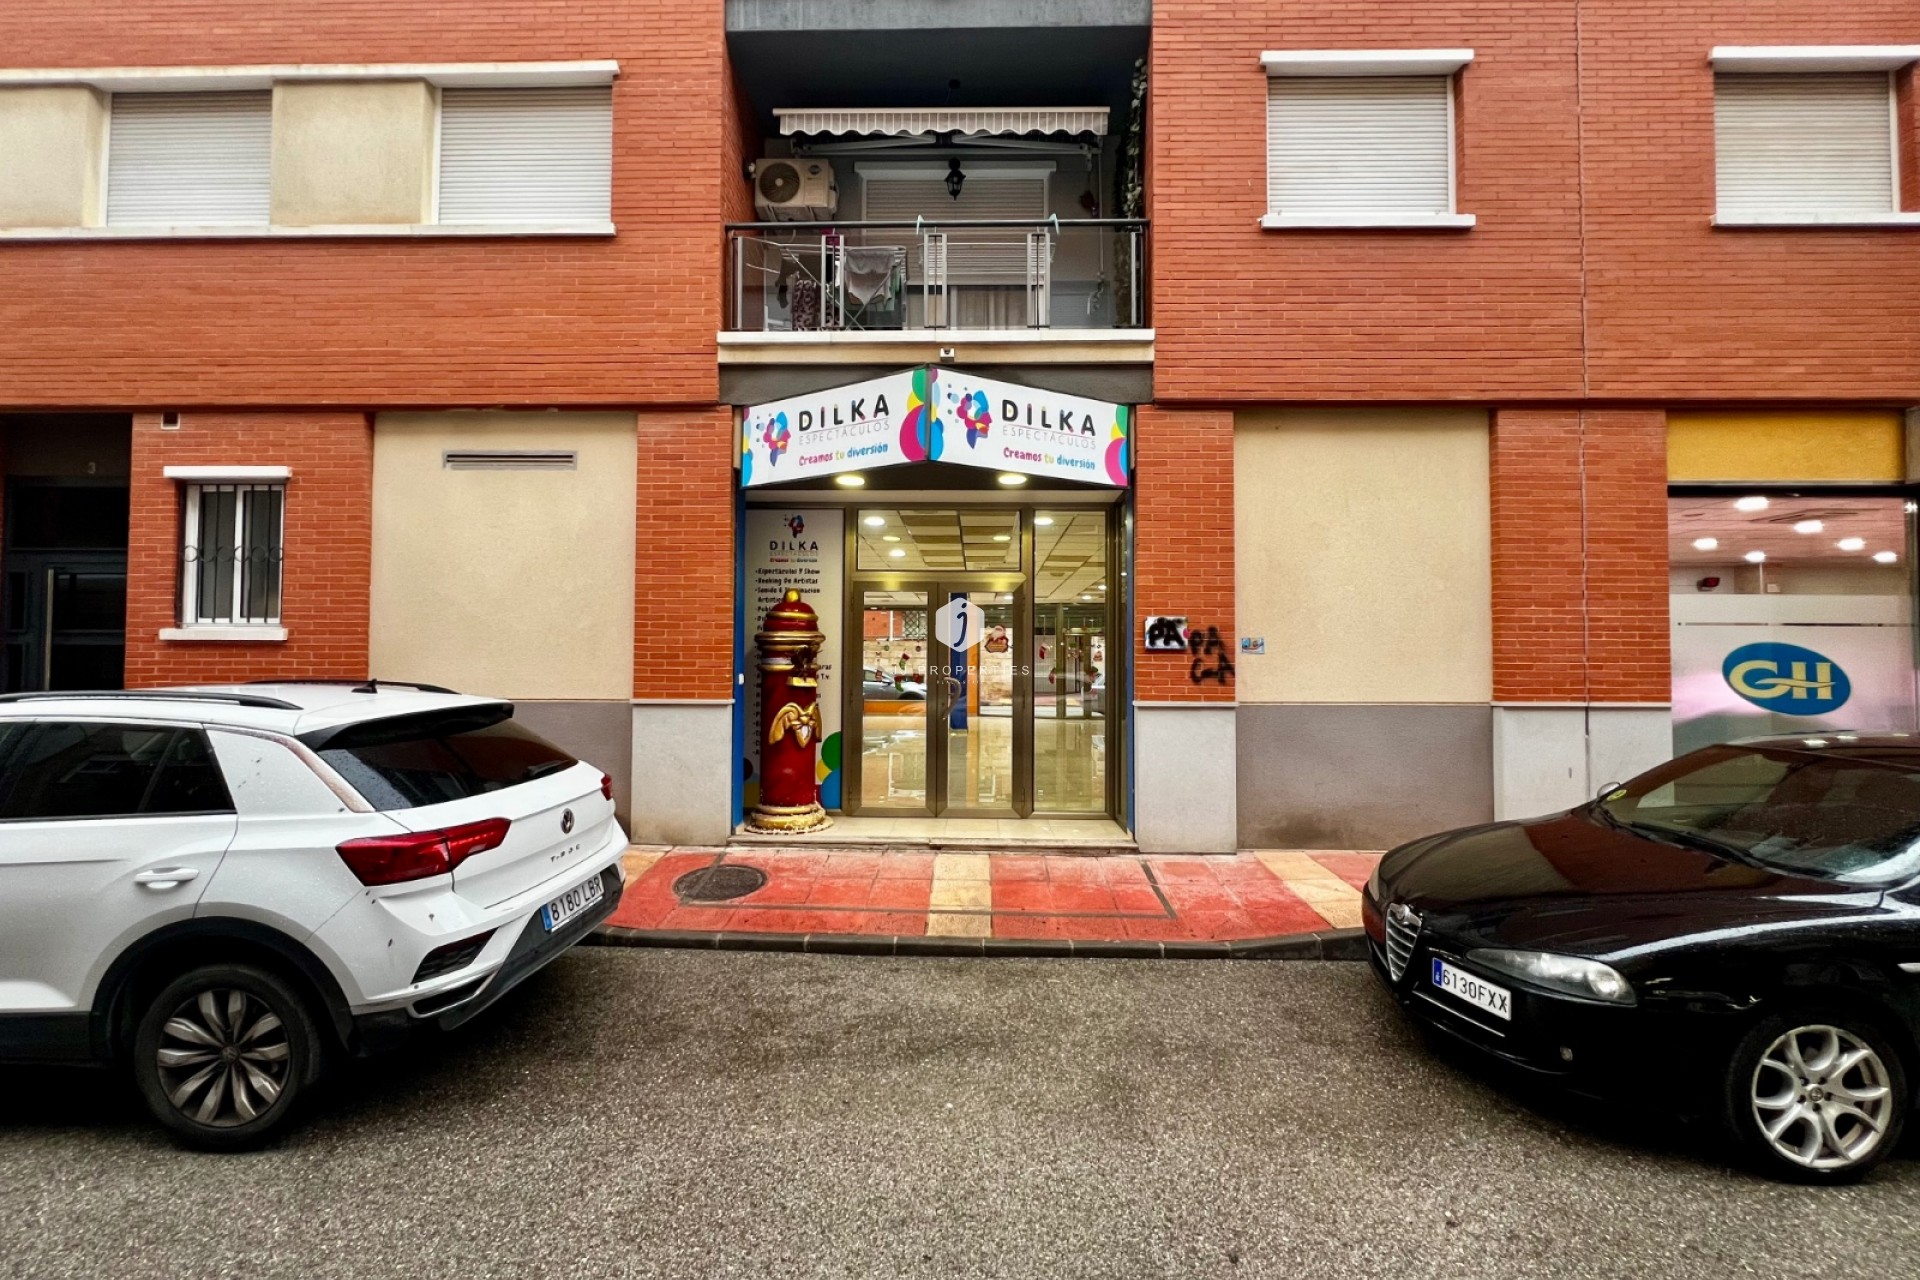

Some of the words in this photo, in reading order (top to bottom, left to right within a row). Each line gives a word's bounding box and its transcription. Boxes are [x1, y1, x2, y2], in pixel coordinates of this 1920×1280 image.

[798, 393, 889, 432] DILKA
[1001, 399, 1096, 437] DILKA
[798, 452, 834, 466] Creamos
[835, 450, 846, 461] tu
[1003, 446, 1043, 462] Creamos
[1044, 453, 1055, 464] tu
[769, 540, 819, 551] DILKA
[1729, 659, 1836, 700] GH
